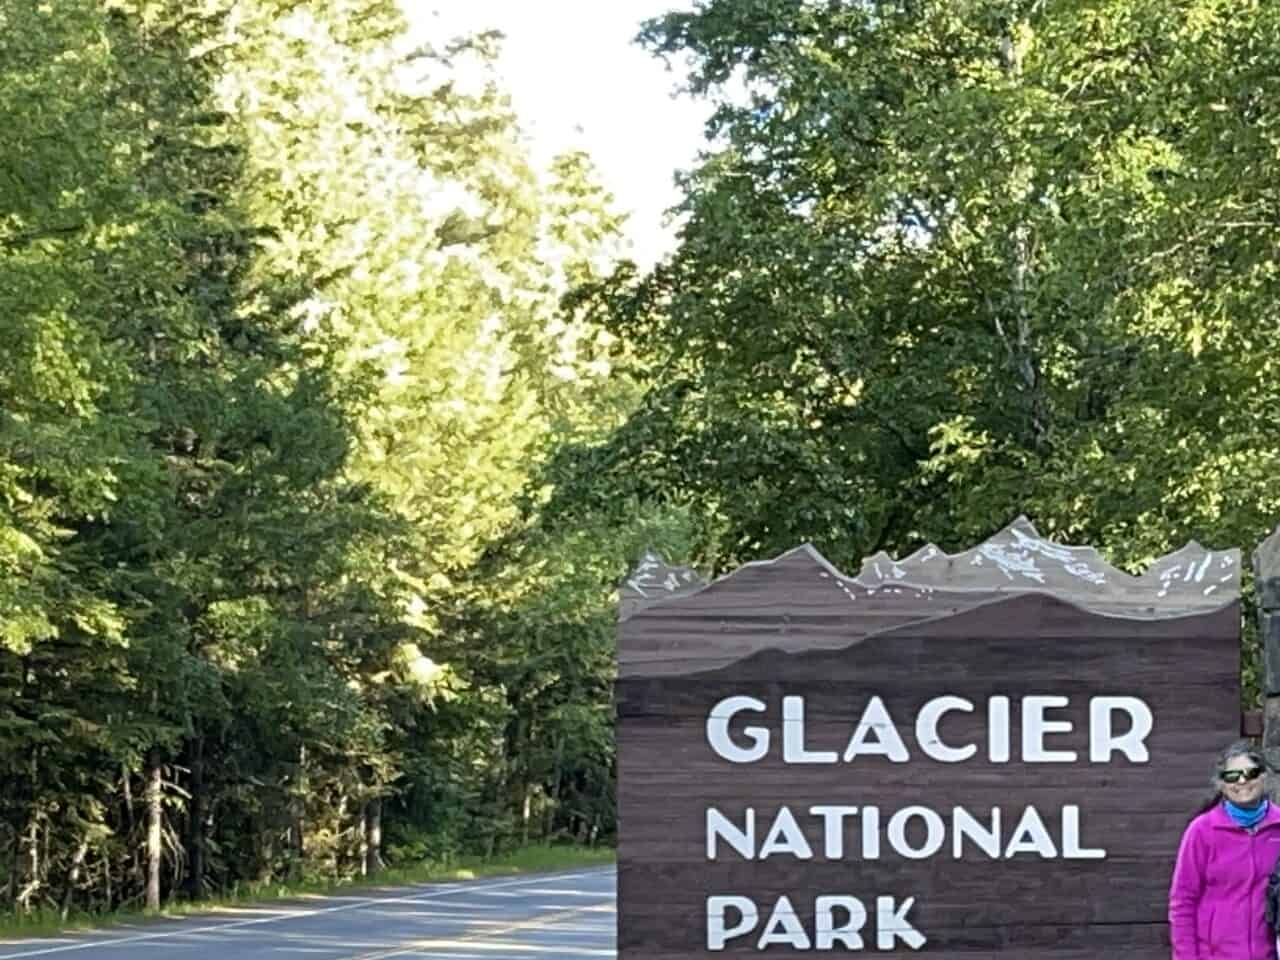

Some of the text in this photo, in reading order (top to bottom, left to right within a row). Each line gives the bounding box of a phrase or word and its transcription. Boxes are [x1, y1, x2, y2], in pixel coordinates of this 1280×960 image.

[706, 695, 1154, 764] GLACIER
[706, 804, 1107, 860] NATIONAL
[706, 895, 928, 951] PARK
